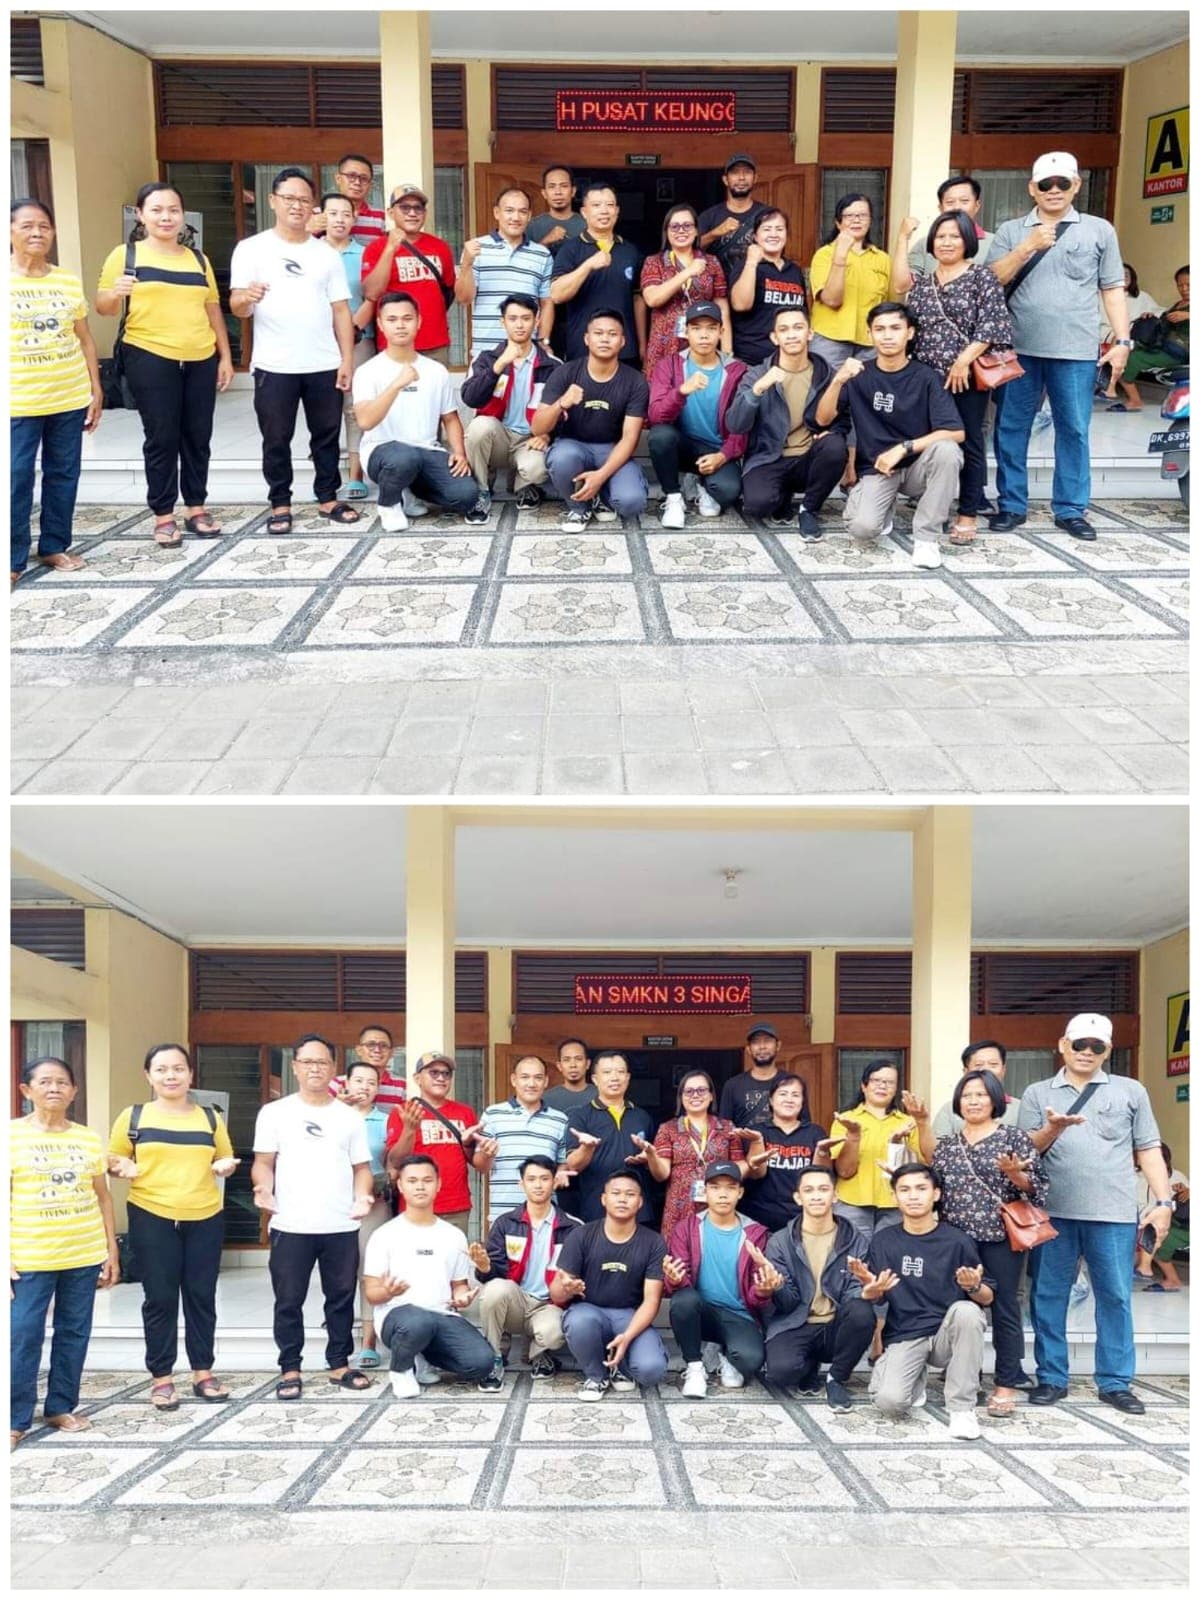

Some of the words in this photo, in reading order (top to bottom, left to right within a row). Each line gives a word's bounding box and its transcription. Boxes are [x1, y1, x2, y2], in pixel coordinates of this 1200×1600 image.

[561, 102, 576, 120] H
[582, 102, 648, 120] PUSAT
[1150, 119, 1183, 174] A
[1147, 178, 1183, 193] KANTOR
[608, 985, 669, 1004] SMKN
[673, 985, 686, 1004] 3
[767, 1154, 811, 1170] ELAJAR
